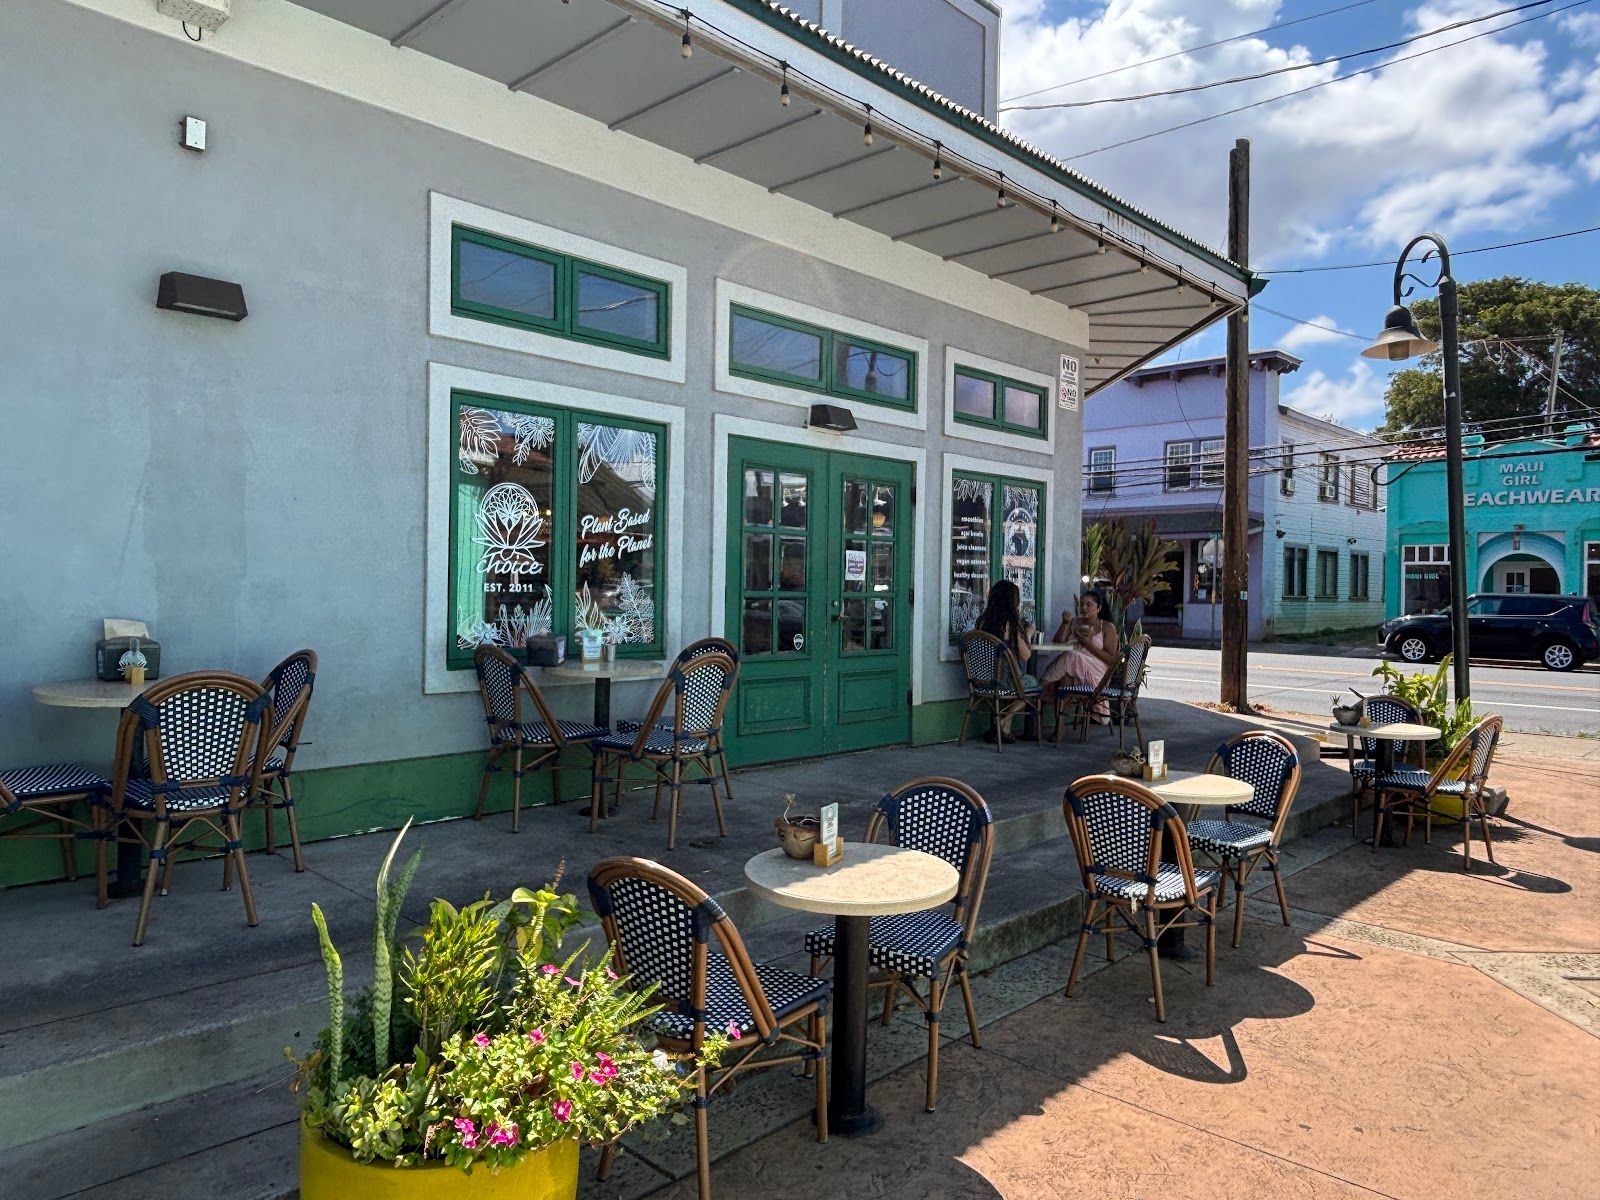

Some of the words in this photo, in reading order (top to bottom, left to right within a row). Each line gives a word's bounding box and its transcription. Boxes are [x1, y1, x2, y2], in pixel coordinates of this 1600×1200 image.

[1062, 358, 1077, 372] NO
[1500, 461, 1545, 473] MAUI
[1502, 474, 1541, 486] GIRL
[1463, 487, 1600, 507] EACHWEAR
[581, 507, 651, 540] Plant-Based
[579, 543, 597, 569] for
[598, 541, 616, 560] the
[617, 533, 653, 560] Planet
[1423, 572, 1440, 580] GIRL
[483, 582, 506, 593] EST.
[508, 583, 533, 593] 2011
